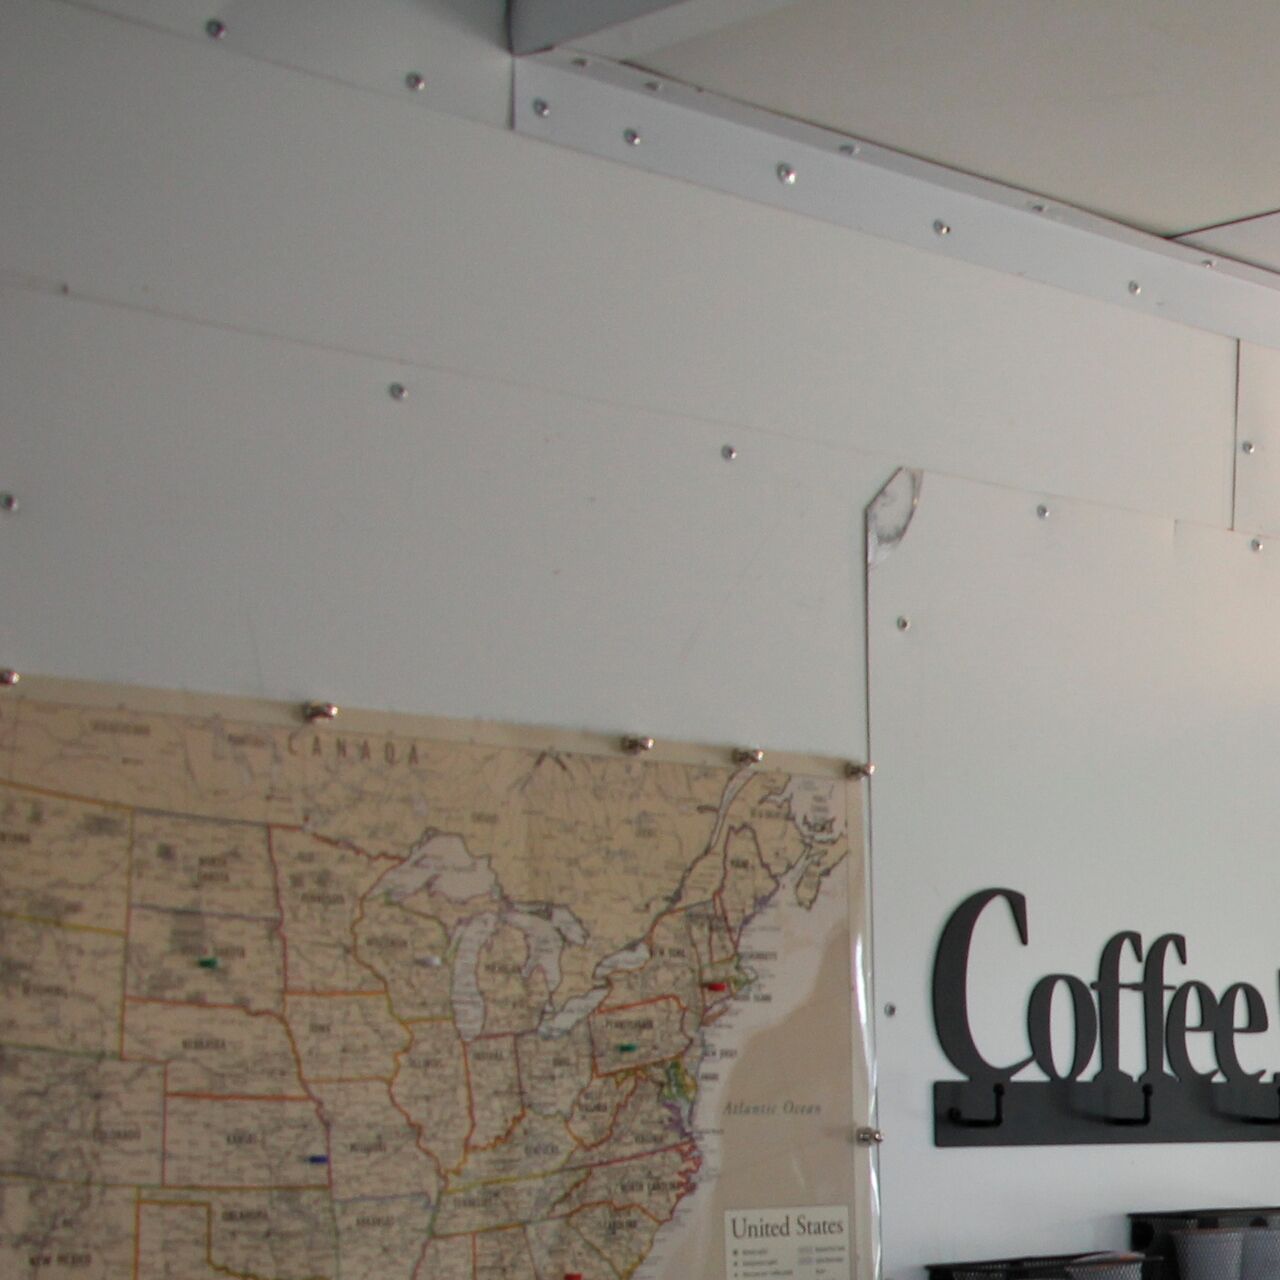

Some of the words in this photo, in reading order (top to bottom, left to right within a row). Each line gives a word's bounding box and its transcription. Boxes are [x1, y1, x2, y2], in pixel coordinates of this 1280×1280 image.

[932, 887, 1269, 1082] Coffee
[723, 1101, 777, 1115] Atlantic
[782, 1101, 822, 1115] Ocean
[731, 1214, 790, 1239] United
[796, 1213, 844, 1236] States
